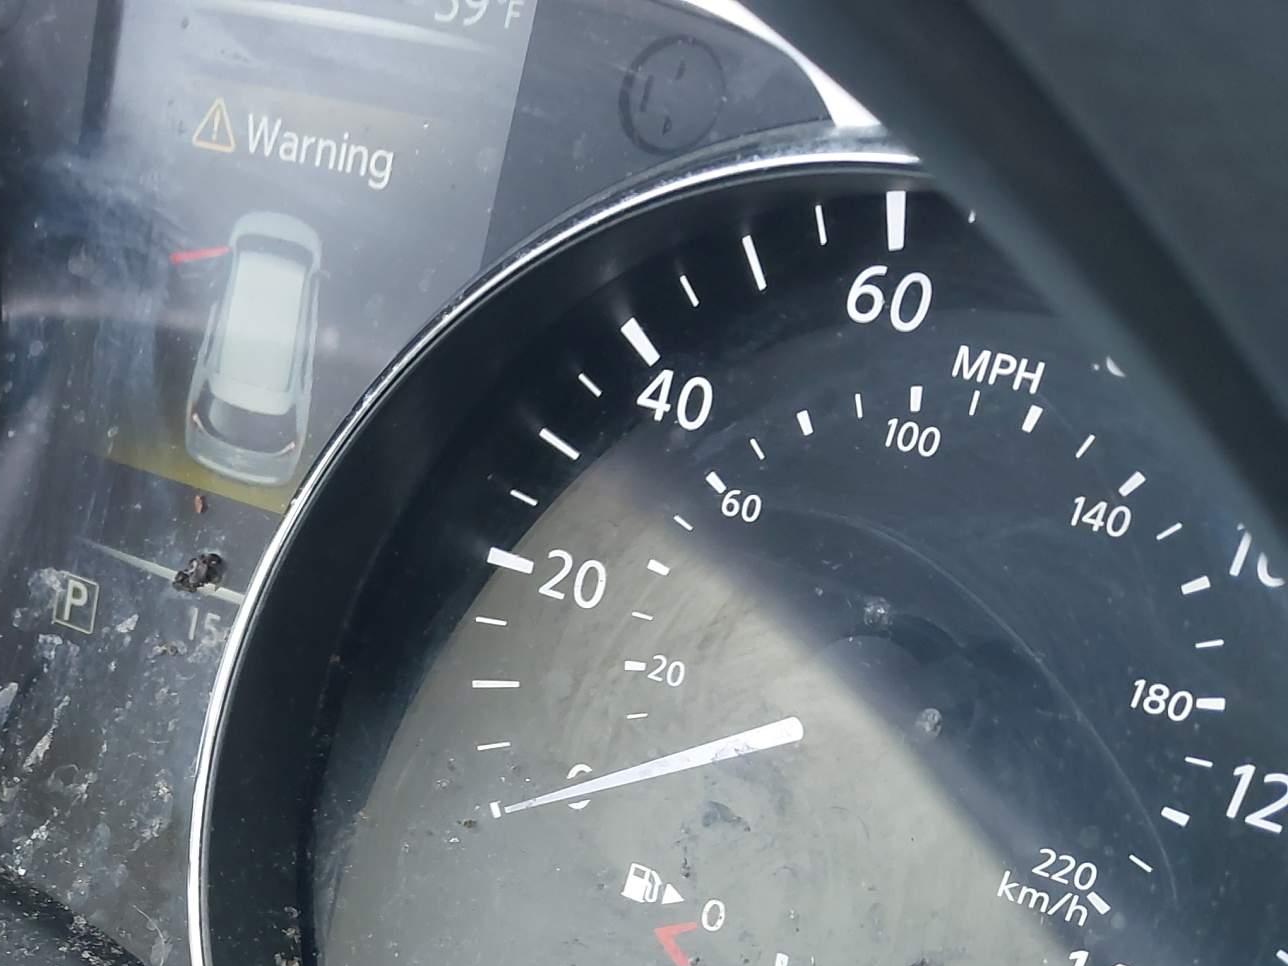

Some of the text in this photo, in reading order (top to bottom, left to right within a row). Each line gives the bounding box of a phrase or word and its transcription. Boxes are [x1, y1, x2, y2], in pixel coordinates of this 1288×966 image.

[247, 112, 394, 189] Warning
[847, 265, 932, 332] 60
[952, 345, 1045, 394] MPH
[637, 369, 713, 431] 40
[885, 418, 941, 457] 100
[720, 488, 762, 523] 60
[1070, 496, 1132, 538] 140
[63, 580, 89, 621] P
[539, 549, 607, 609] 20
[647, 654, 686, 687] 20
[1130, 679, 1194, 722] 180
[1226, 764, 1288, 834] 12
[1028, 848, 1098, 892] 220
[701, 899, 726, 932] 0
[997, 870, 1089, 927] km/h
